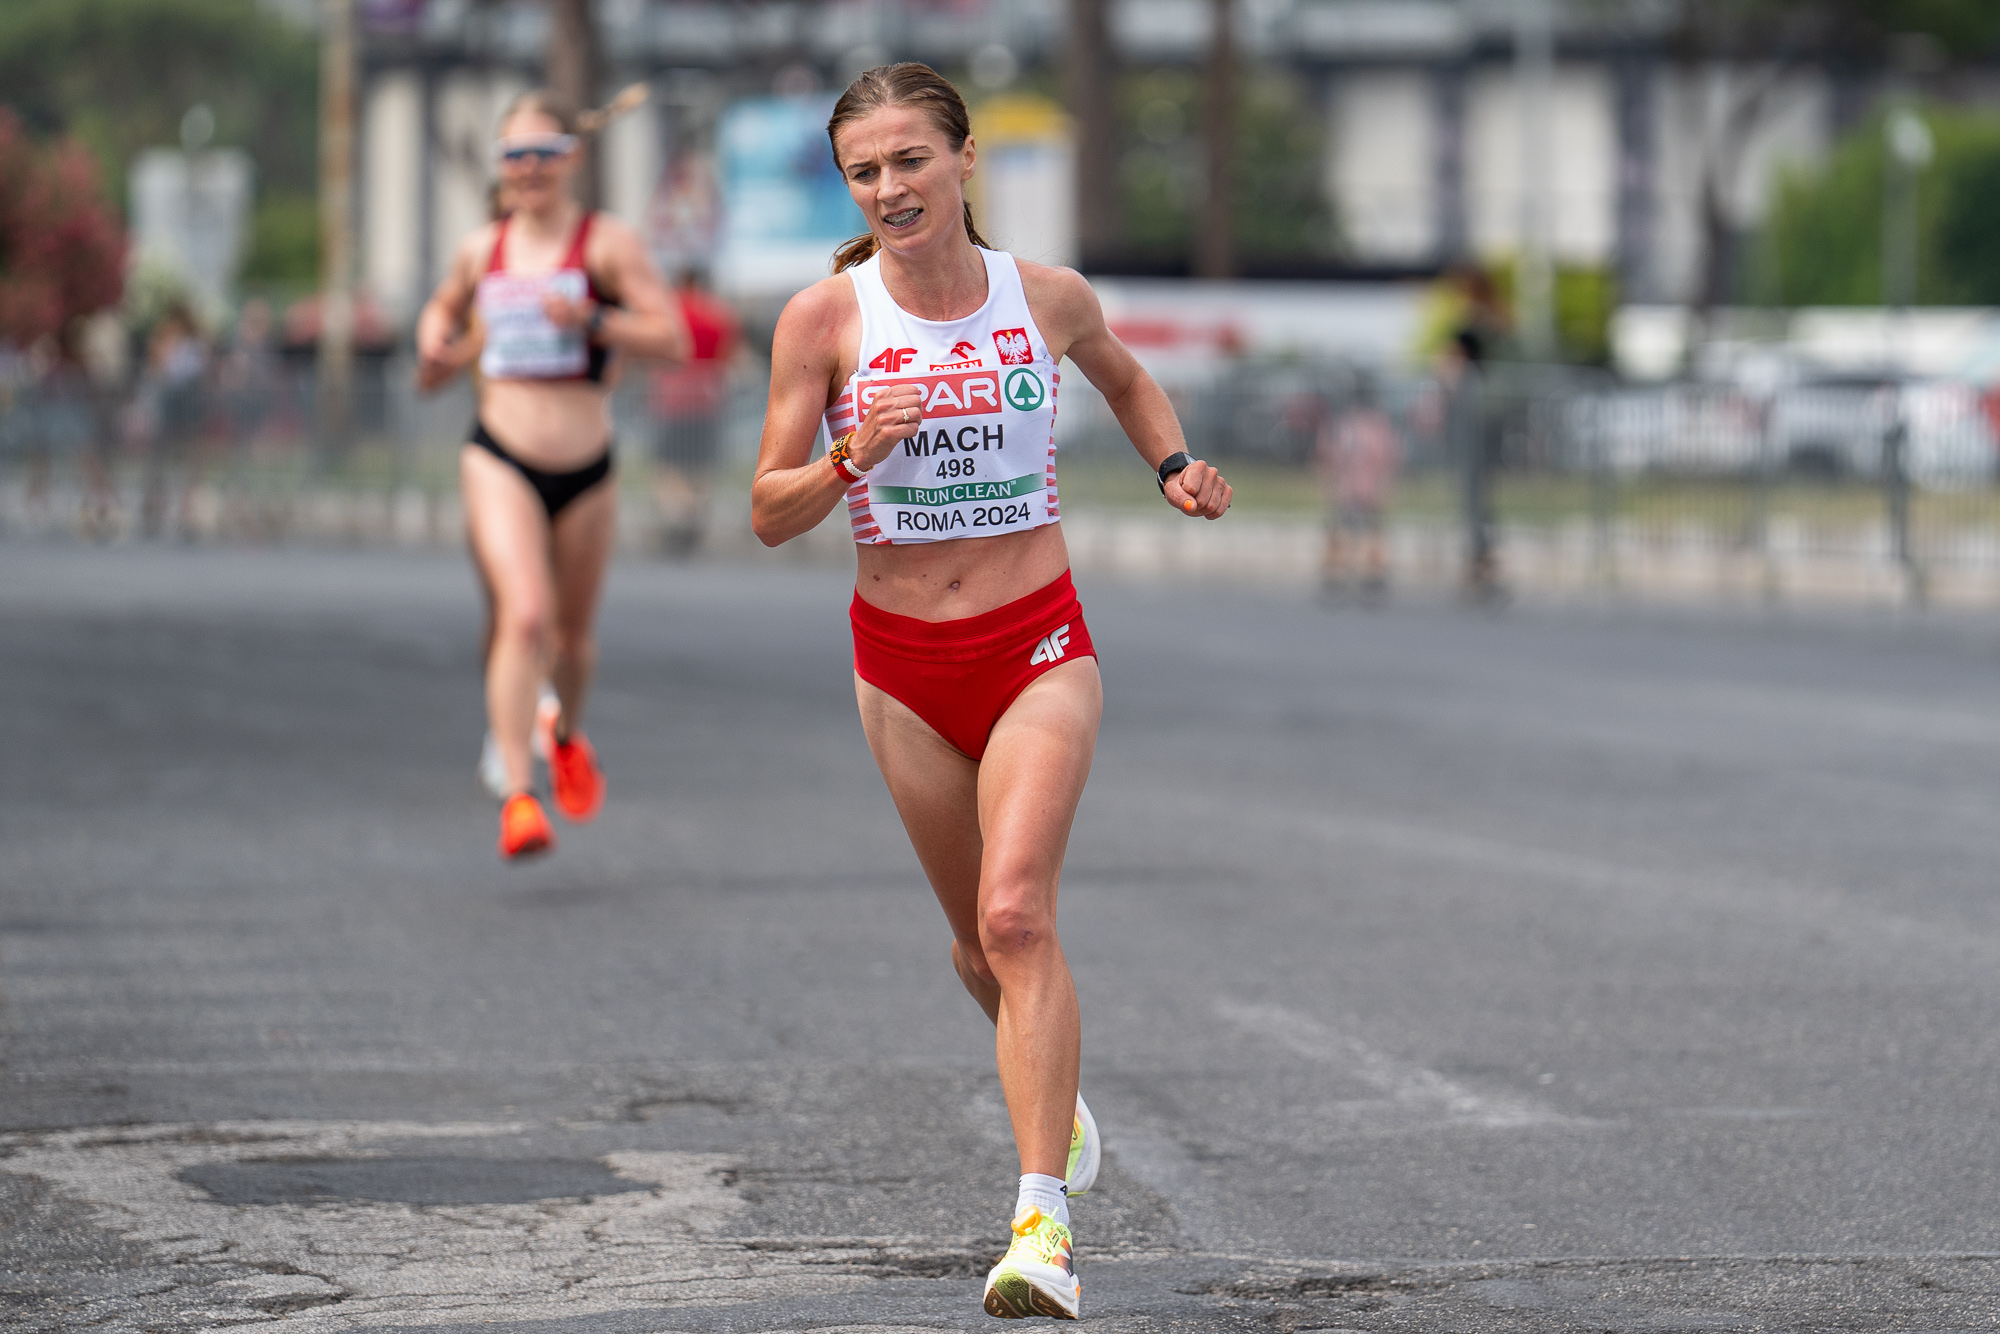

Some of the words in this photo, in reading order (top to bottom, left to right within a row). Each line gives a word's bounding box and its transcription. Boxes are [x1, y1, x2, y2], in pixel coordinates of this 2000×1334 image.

[869, 347, 918, 373] 4F
[904, 424, 1003, 456] MACH
[936, 457, 975, 479] 498
[907, 489, 912, 502] I
[915, 488, 949, 504] RUN
[897, 509, 966, 532] ROMA
[972, 502, 1031, 527] 2024
[1030, 623, 1070, 666] 4F
